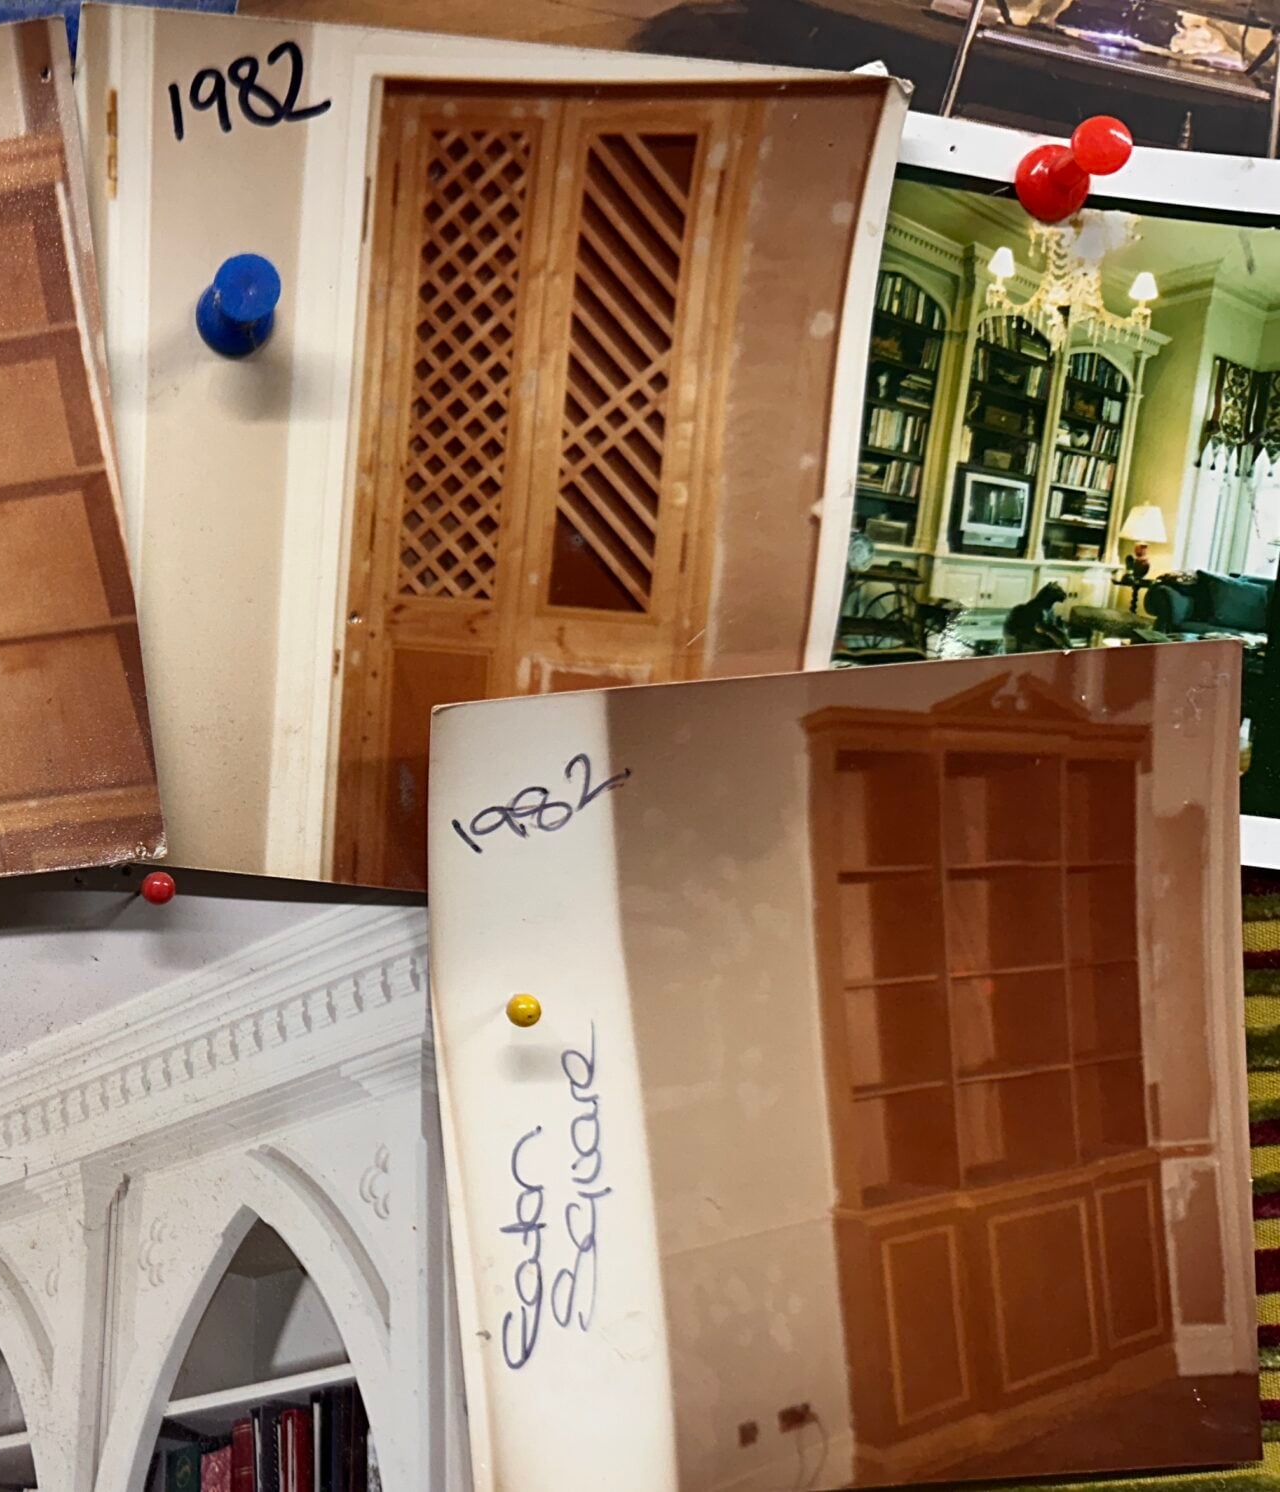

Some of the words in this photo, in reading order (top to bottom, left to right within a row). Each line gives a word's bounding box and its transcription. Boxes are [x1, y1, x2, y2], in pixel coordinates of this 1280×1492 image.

[168, 40, 331, 141] 1982
[451, 754, 631, 853] 1982
[500, 1125, 549, 1370] Eaton
[551, 1019, 612, 1332] Square
